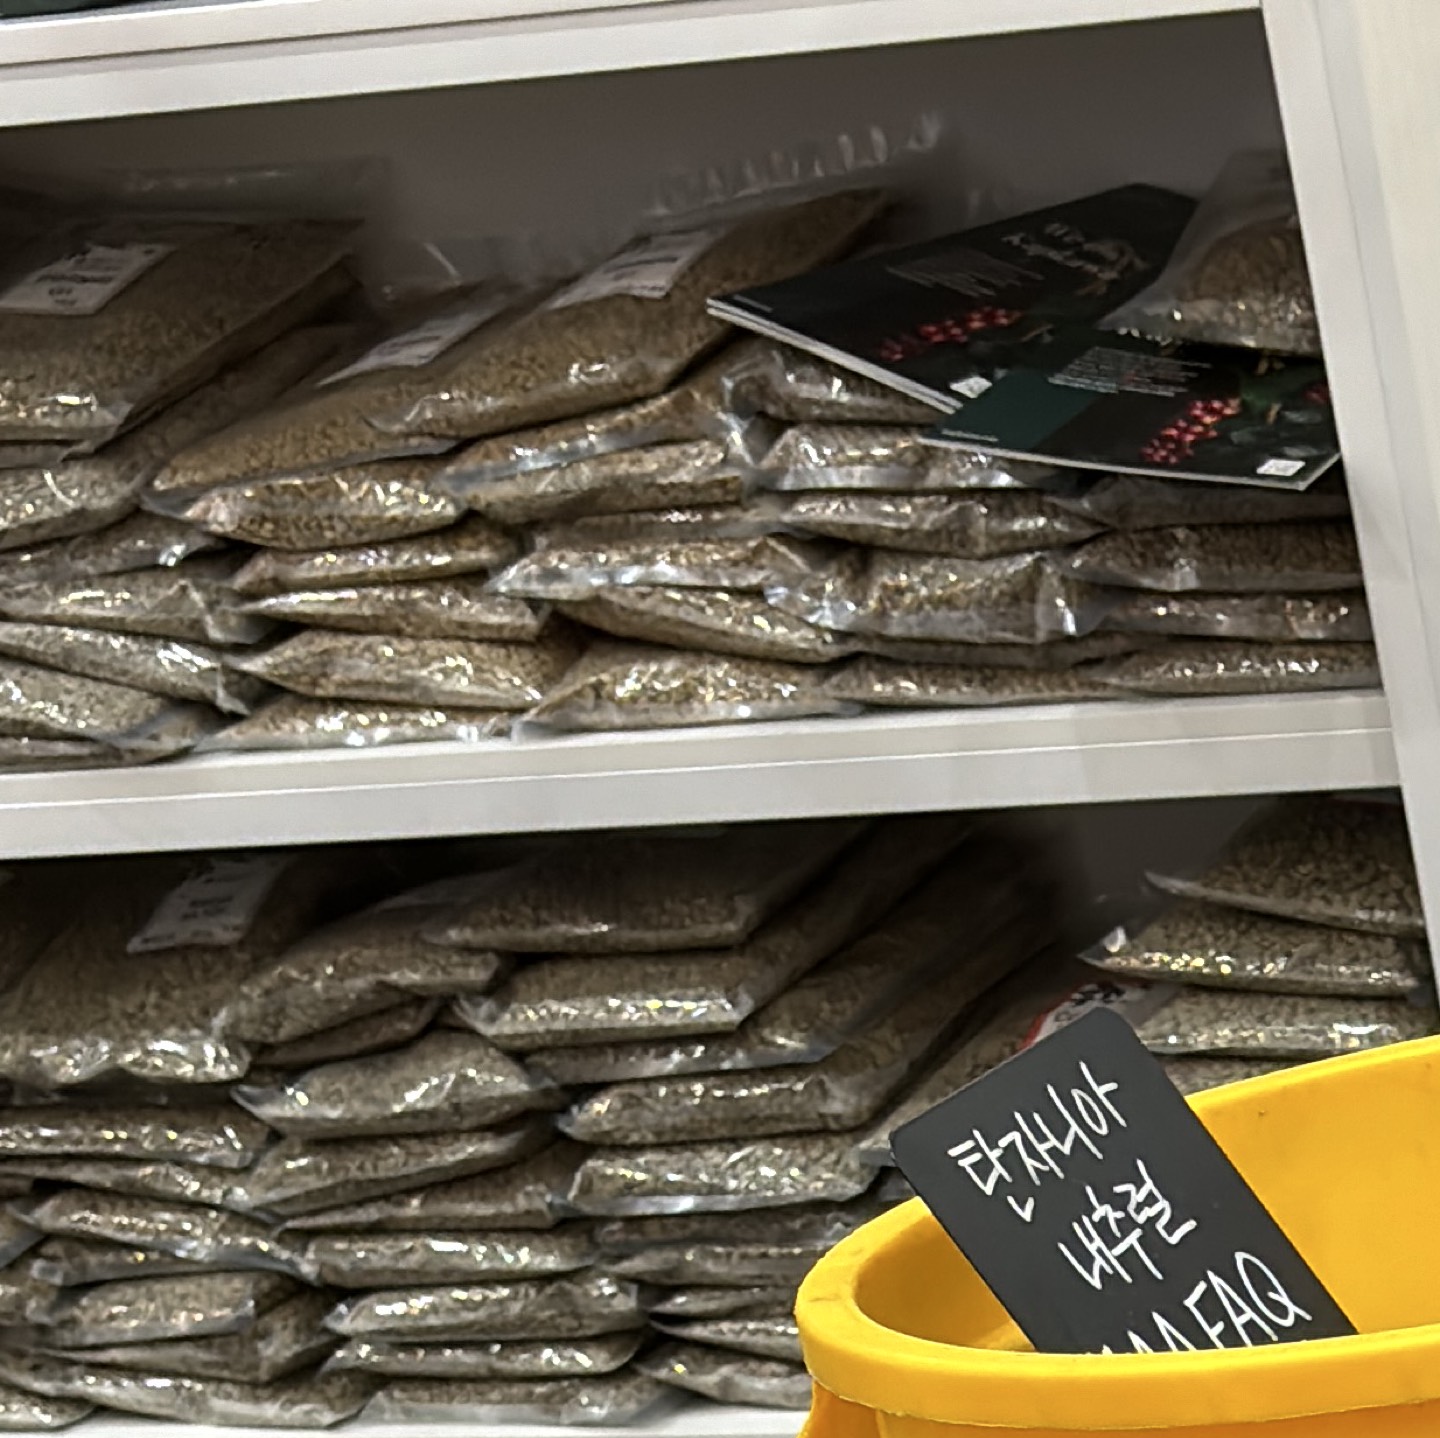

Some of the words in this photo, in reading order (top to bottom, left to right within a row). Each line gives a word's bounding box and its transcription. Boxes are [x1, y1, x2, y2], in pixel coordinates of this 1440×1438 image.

[948, 1061, 1127, 1224] 탄자니아
[1057, 1159, 1198, 1290] 내추럴
[1183, 1251, 1313, 1350] FAQ
